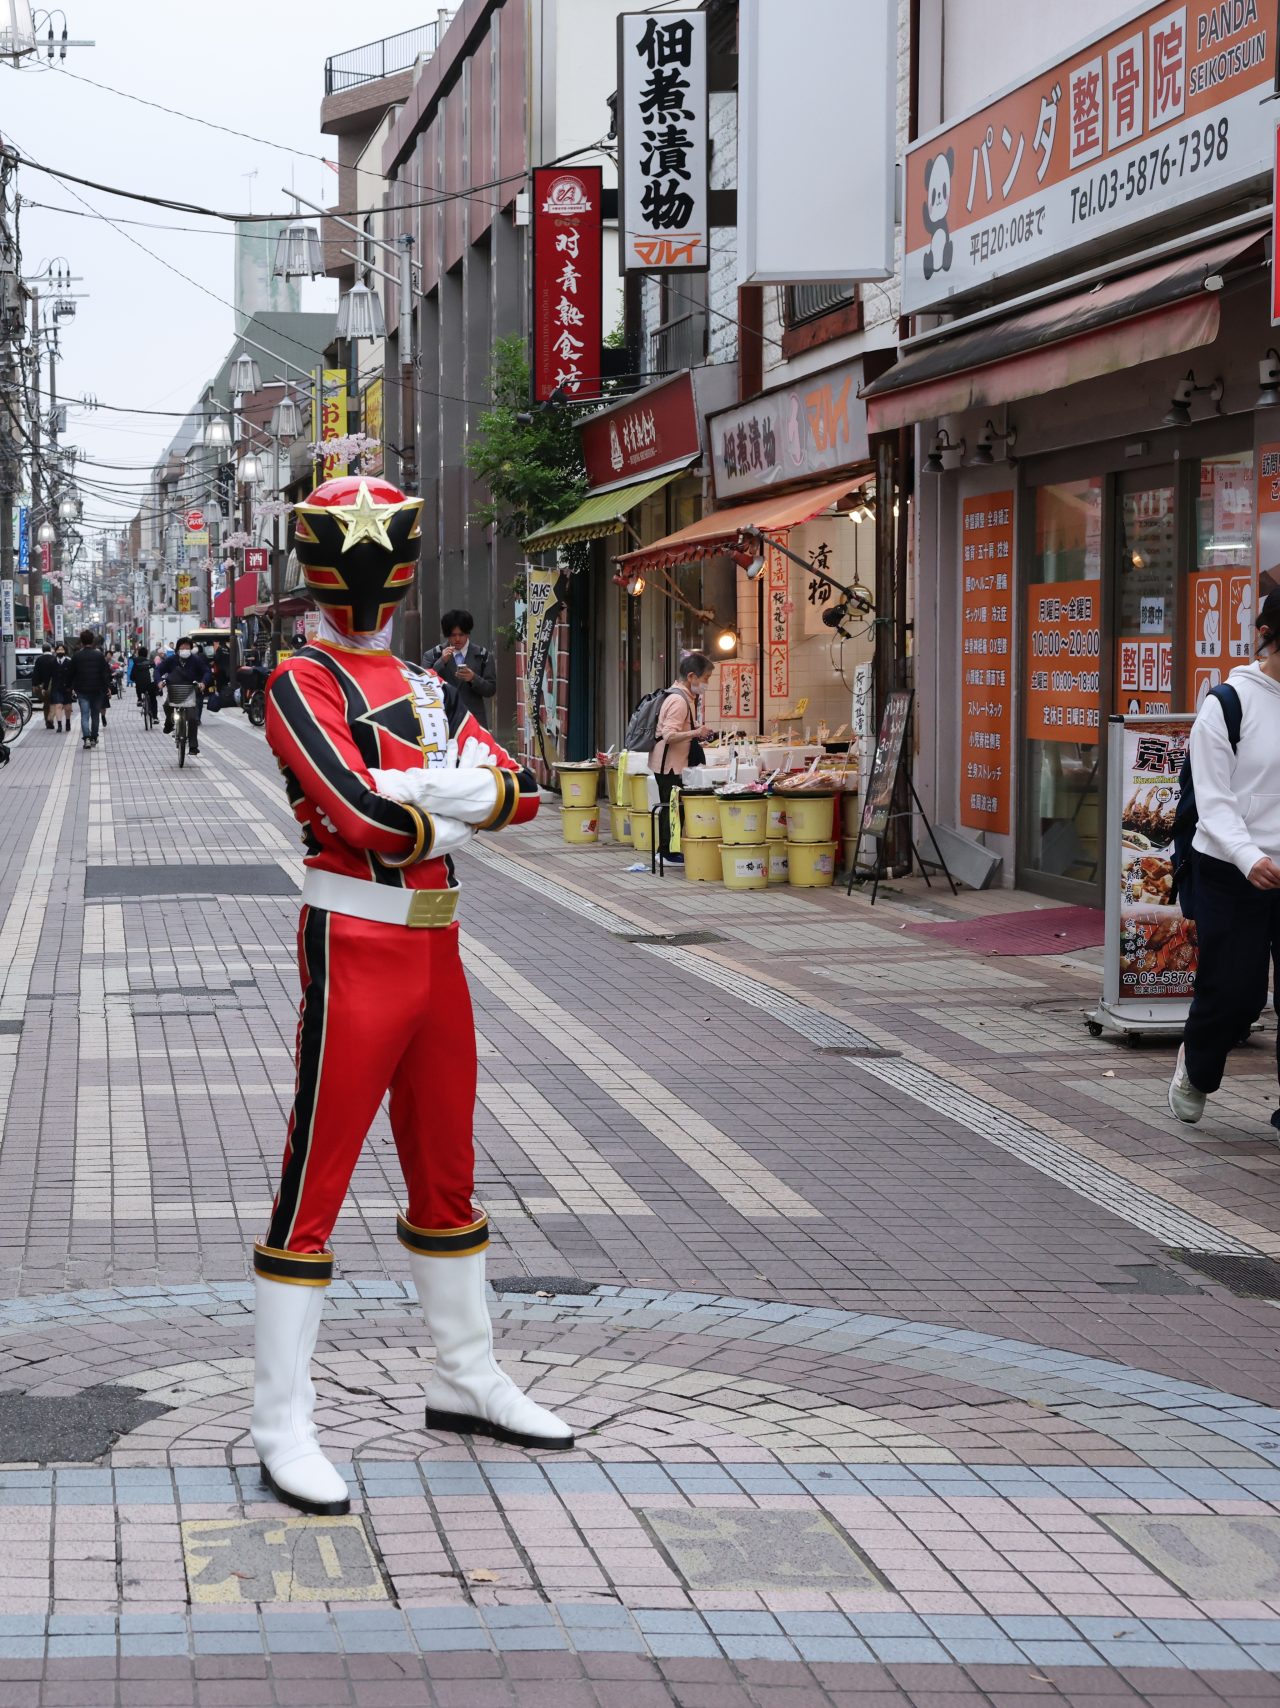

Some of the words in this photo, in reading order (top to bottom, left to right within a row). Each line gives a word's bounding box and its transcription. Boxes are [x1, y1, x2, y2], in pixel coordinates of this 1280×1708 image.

[1197, 0, 1259, 51] PANDA
[1189, 31, 1267, 95] SEIKOTSUIN
[1072, 20, 1183, 158] 整骨院
[636, 18, 695, 230] 佃煮漬物
[966, 81, 1062, 214] パンダ
[1070, 117, 1229, 224] Tel.03-5876-7398
[633, 239, 701, 265] マルイ
[969, 205, 1046, 266] 平日20:00まで
[553, 227, 585, 393] 对青熟食坊
[805, 374, 853, 450] マルイ
[724, 416, 777, 480] 佃煮漬物
[248, 552, 263, 567] 酒
[808, 542, 833, 605] 漬物
[1038, 597, 1093, 623] 月曜日～金曜日
[1141, 606, 1163, 625] 診療中
[1032, 629, 1100, 657] 10:00～20:00
[1031, 671, 1049, 692] 土曜日
[1051, 671, 1100, 693] 10:00～18:00
[1122, 646, 1174, 688] 整骨院
[967, 701, 1003, 718] ストレートネック
[1043, 705, 1063, 726] 定休日
[1066, 707, 1085, 726] 日曜日
[1086, 708, 1100, 728] 祝日
[967, 762, 1002, 781] 全身ストレッチ
[1140, 971, 1196, 985] 03-5876
